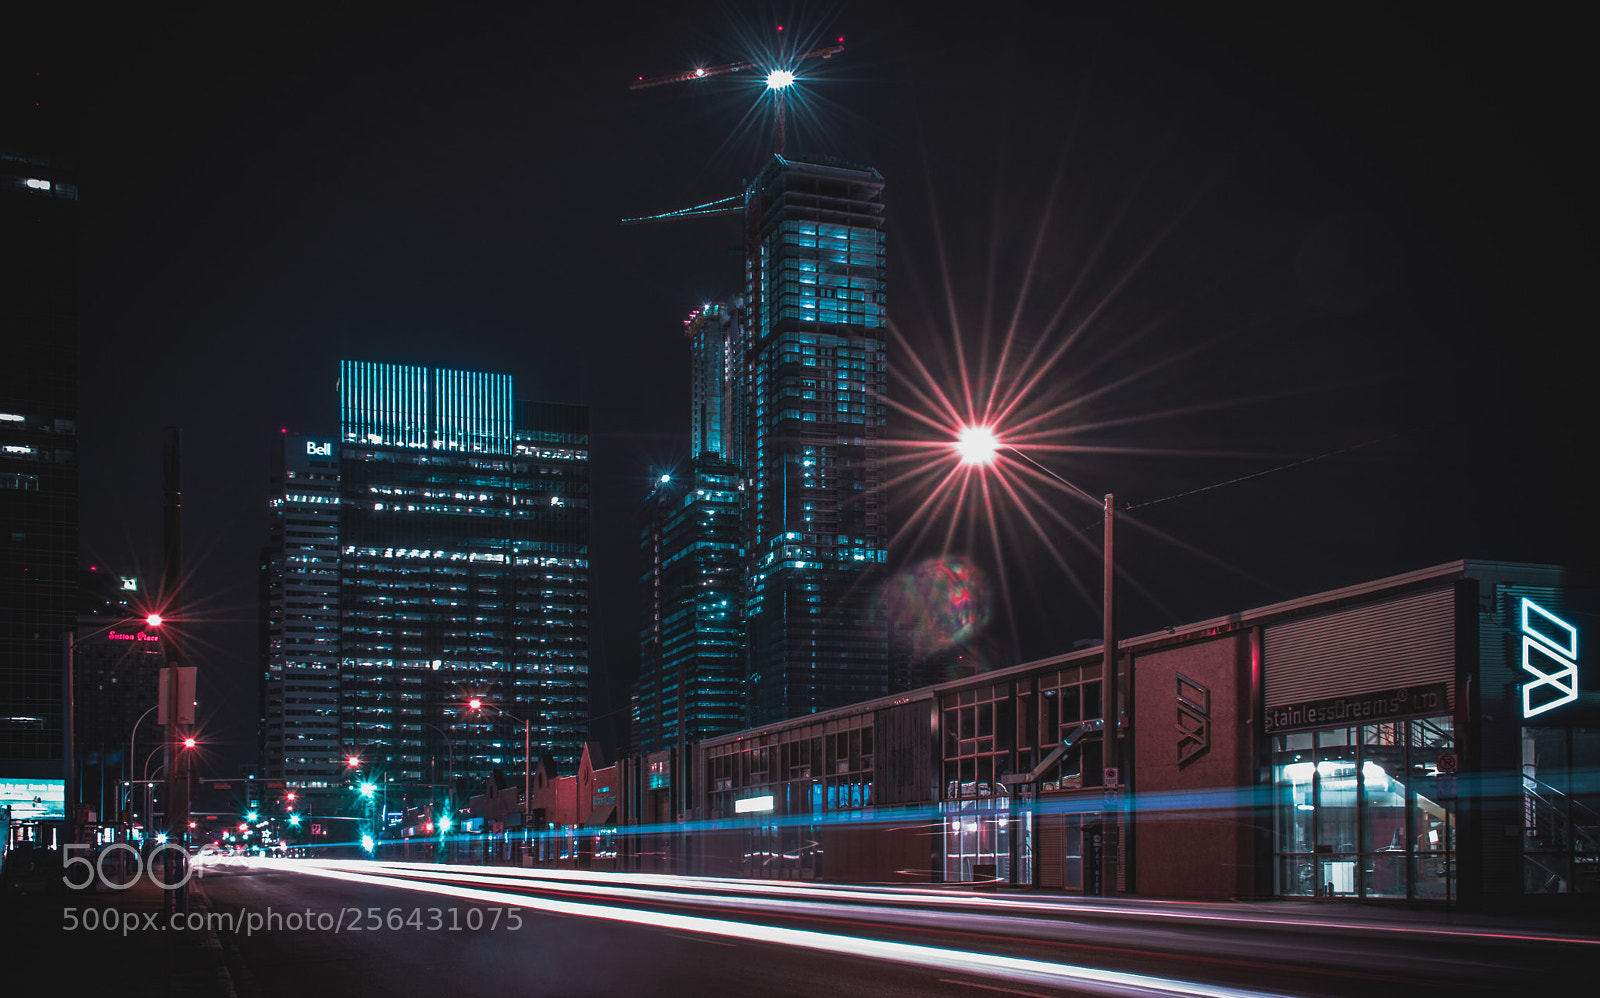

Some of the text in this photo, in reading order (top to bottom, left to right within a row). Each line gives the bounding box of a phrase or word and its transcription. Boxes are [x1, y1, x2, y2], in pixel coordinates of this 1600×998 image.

[306, 441, 332, 456] Bell
[108, 630, 159, 642] Sutton Place
[1413, 692, 1438, 710] LTD
